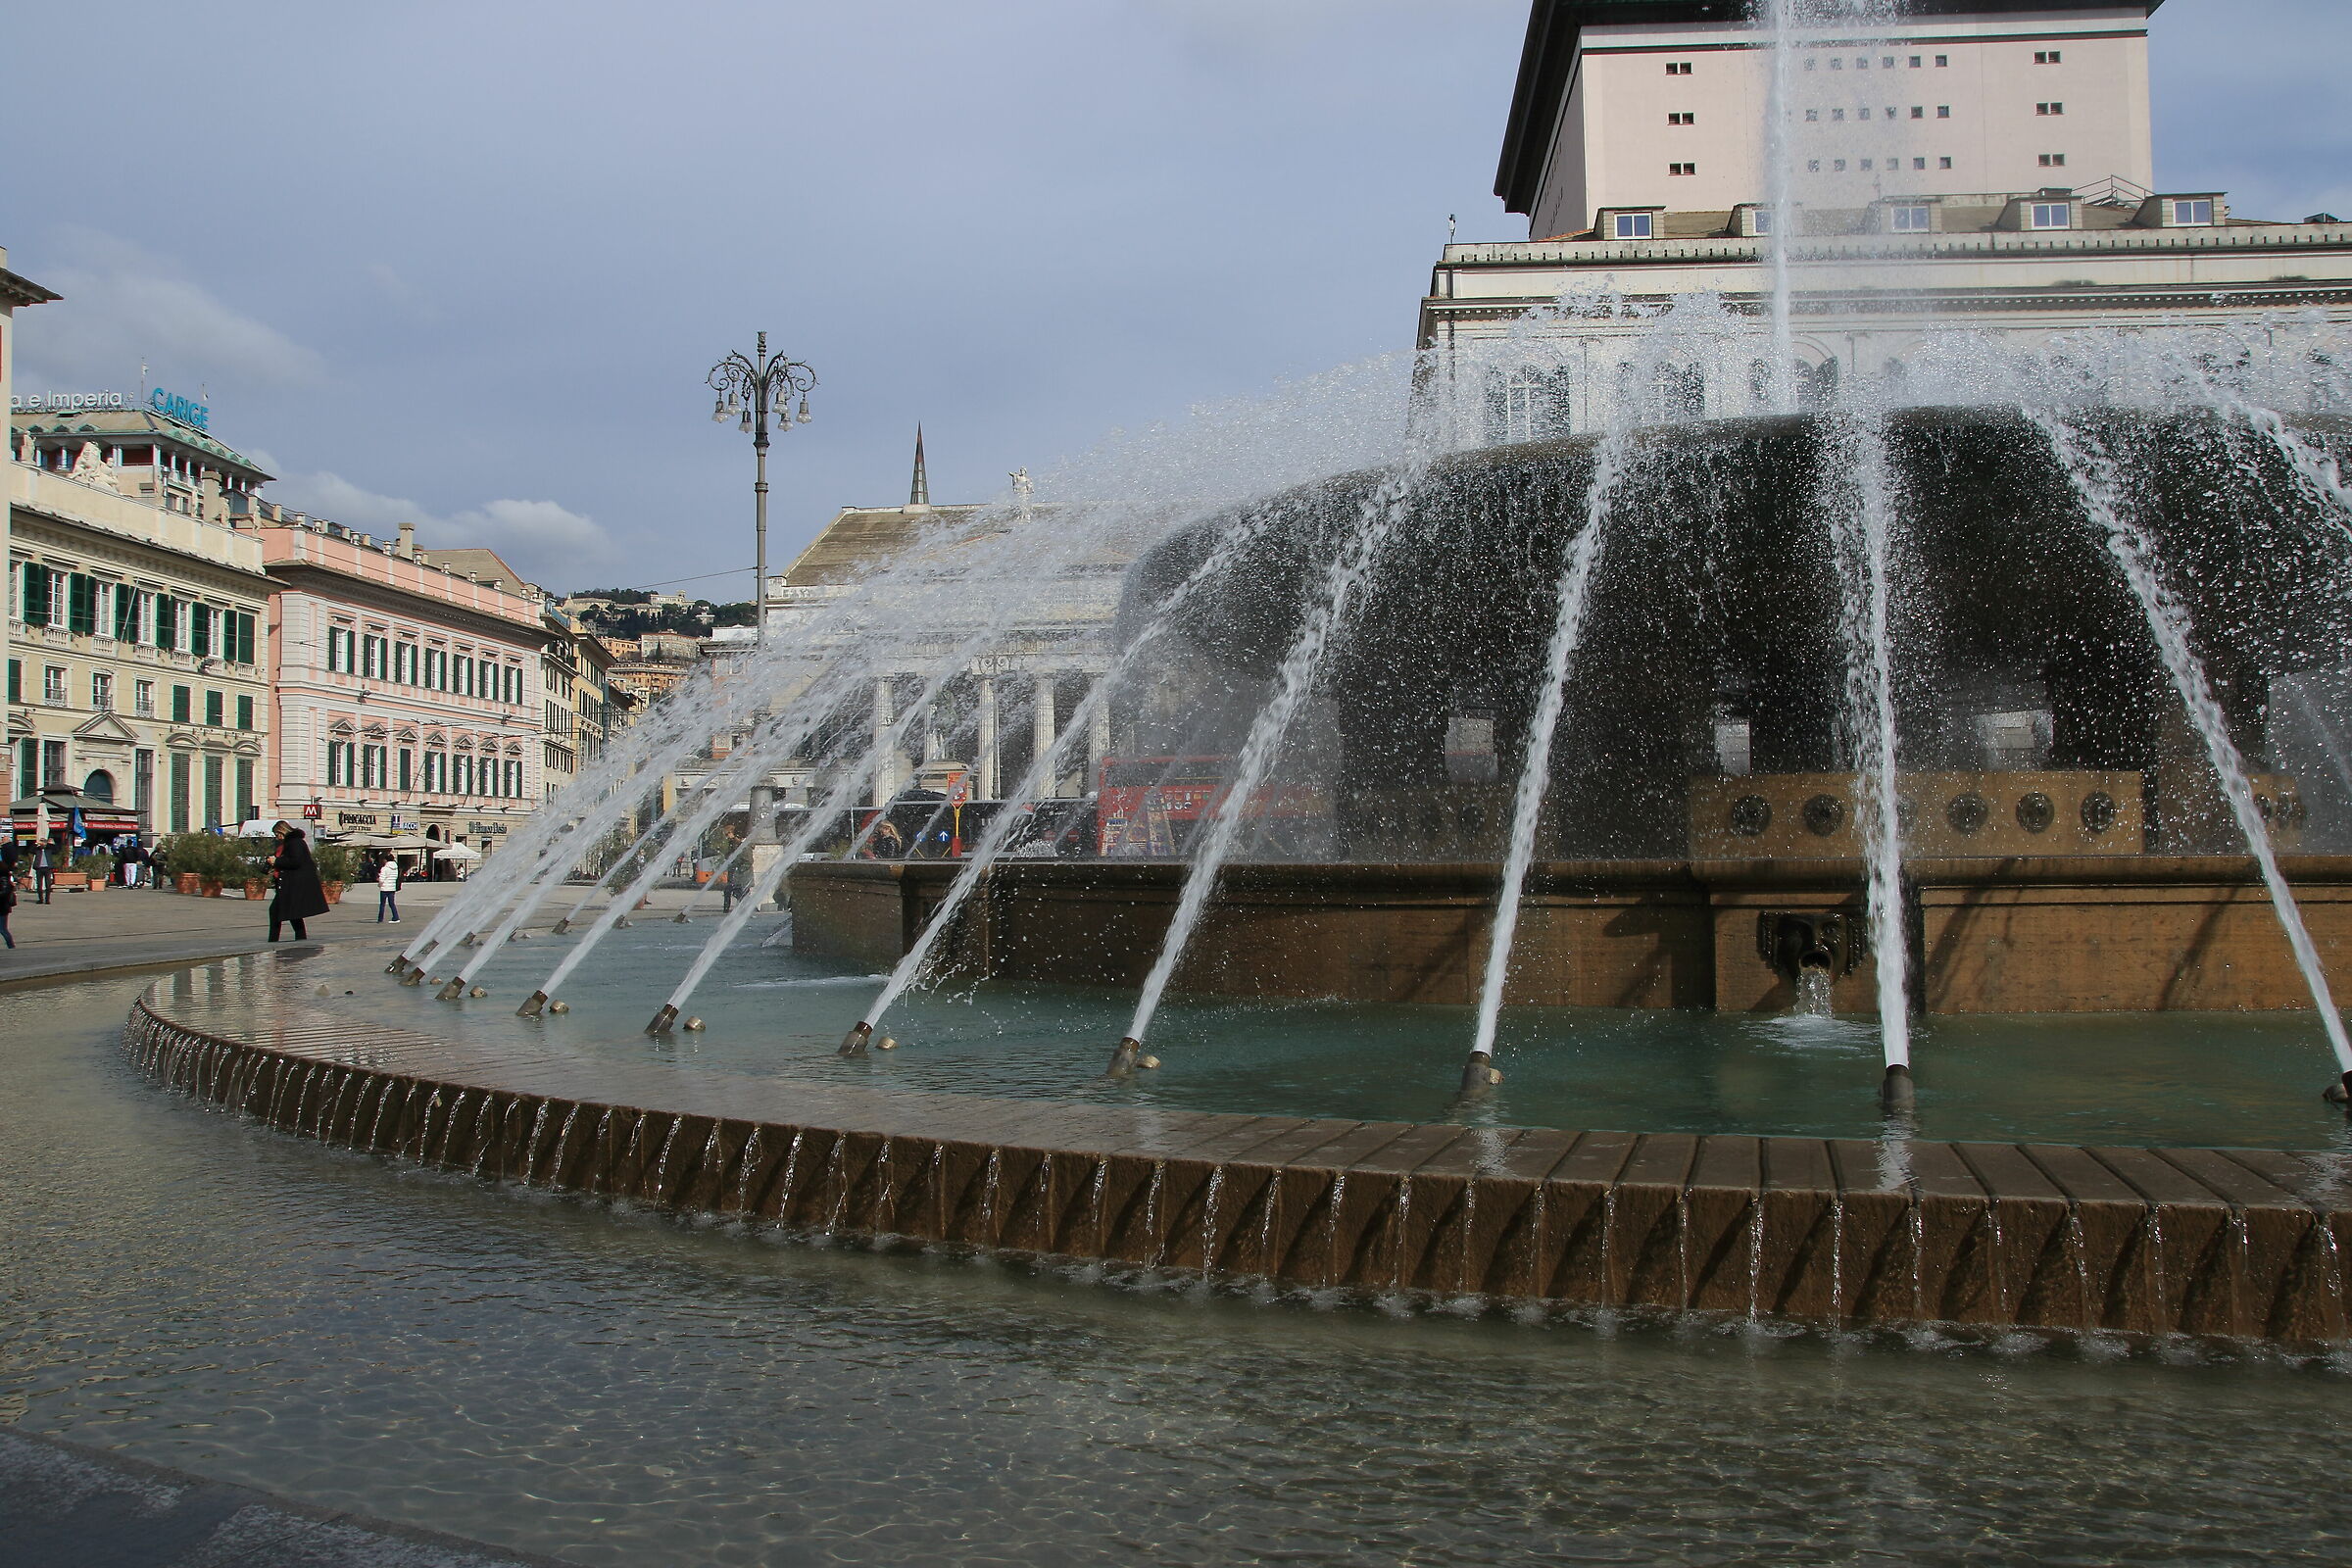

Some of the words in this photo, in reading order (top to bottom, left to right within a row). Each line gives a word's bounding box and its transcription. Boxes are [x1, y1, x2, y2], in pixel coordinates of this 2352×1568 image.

[28, 396, 41, 408] e
[49, 389, 122, 409] Imperia
[153, 387, 210, 429] CARIGE
